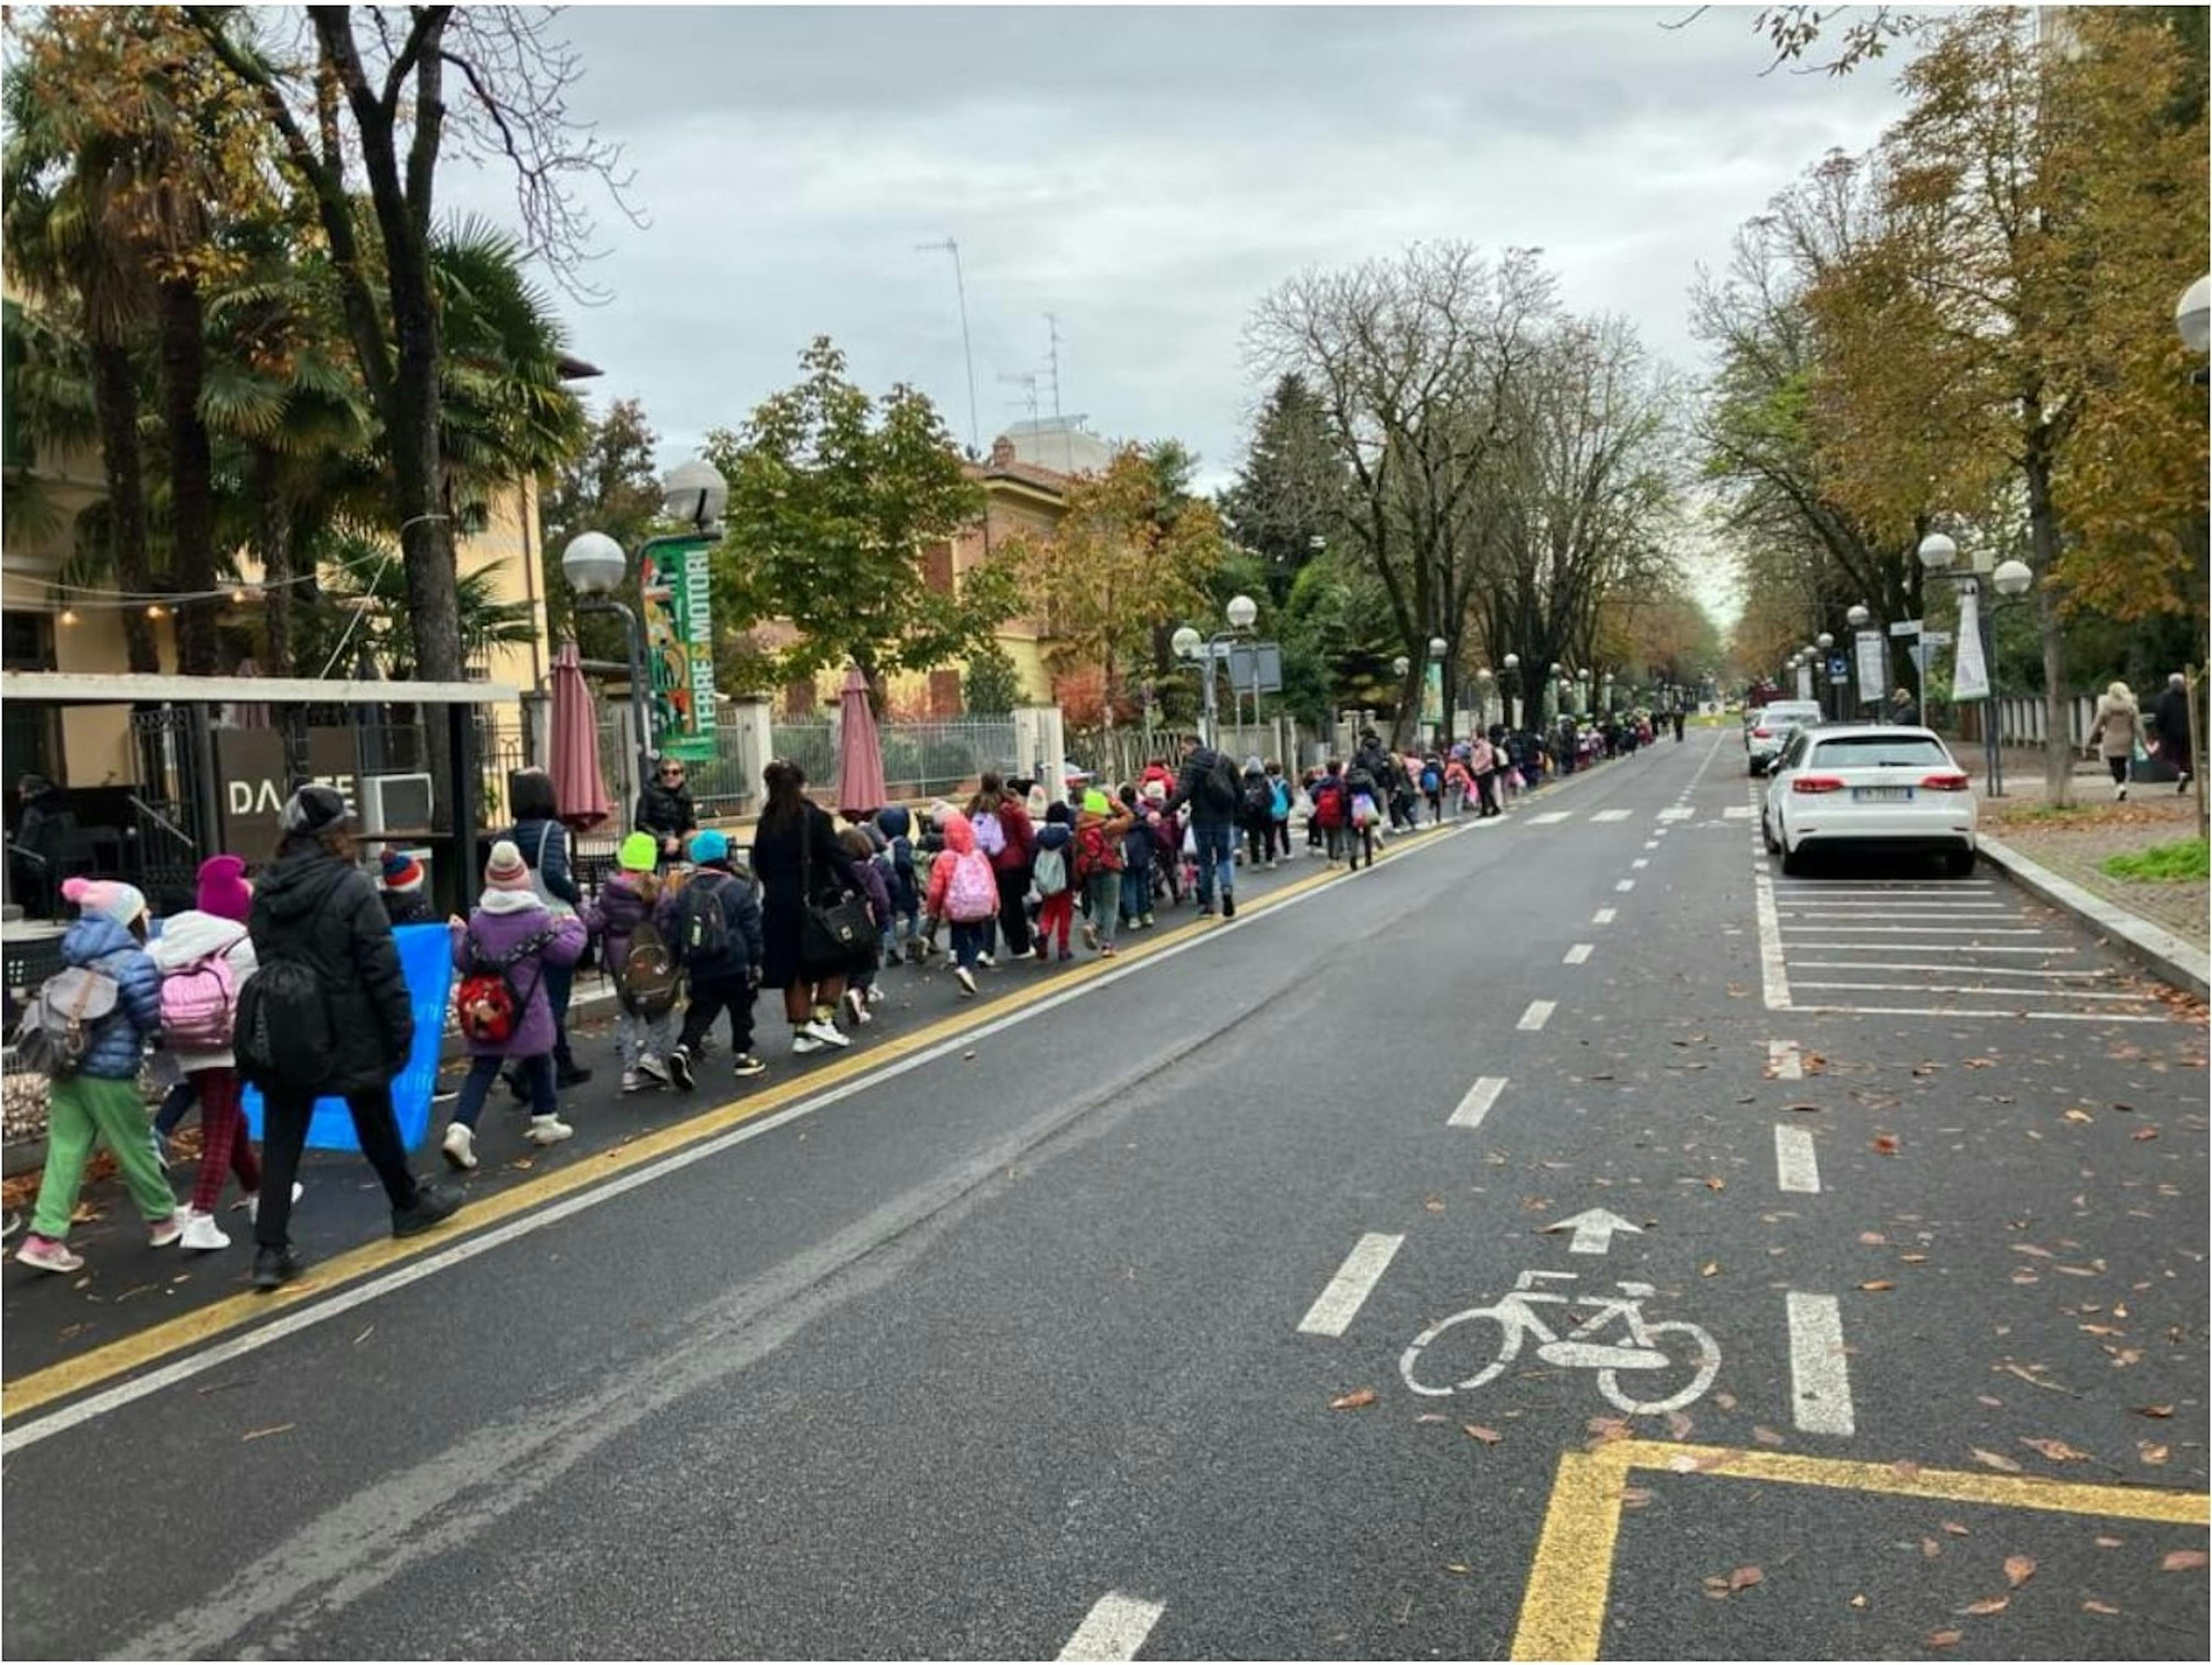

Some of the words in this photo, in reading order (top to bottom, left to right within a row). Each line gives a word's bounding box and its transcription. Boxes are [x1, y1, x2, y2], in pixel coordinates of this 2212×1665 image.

[685, 550, 712, 642] MOTORI
[692, 661, 715, 733] TERRE
[229, 774, 358, 817] DAE
